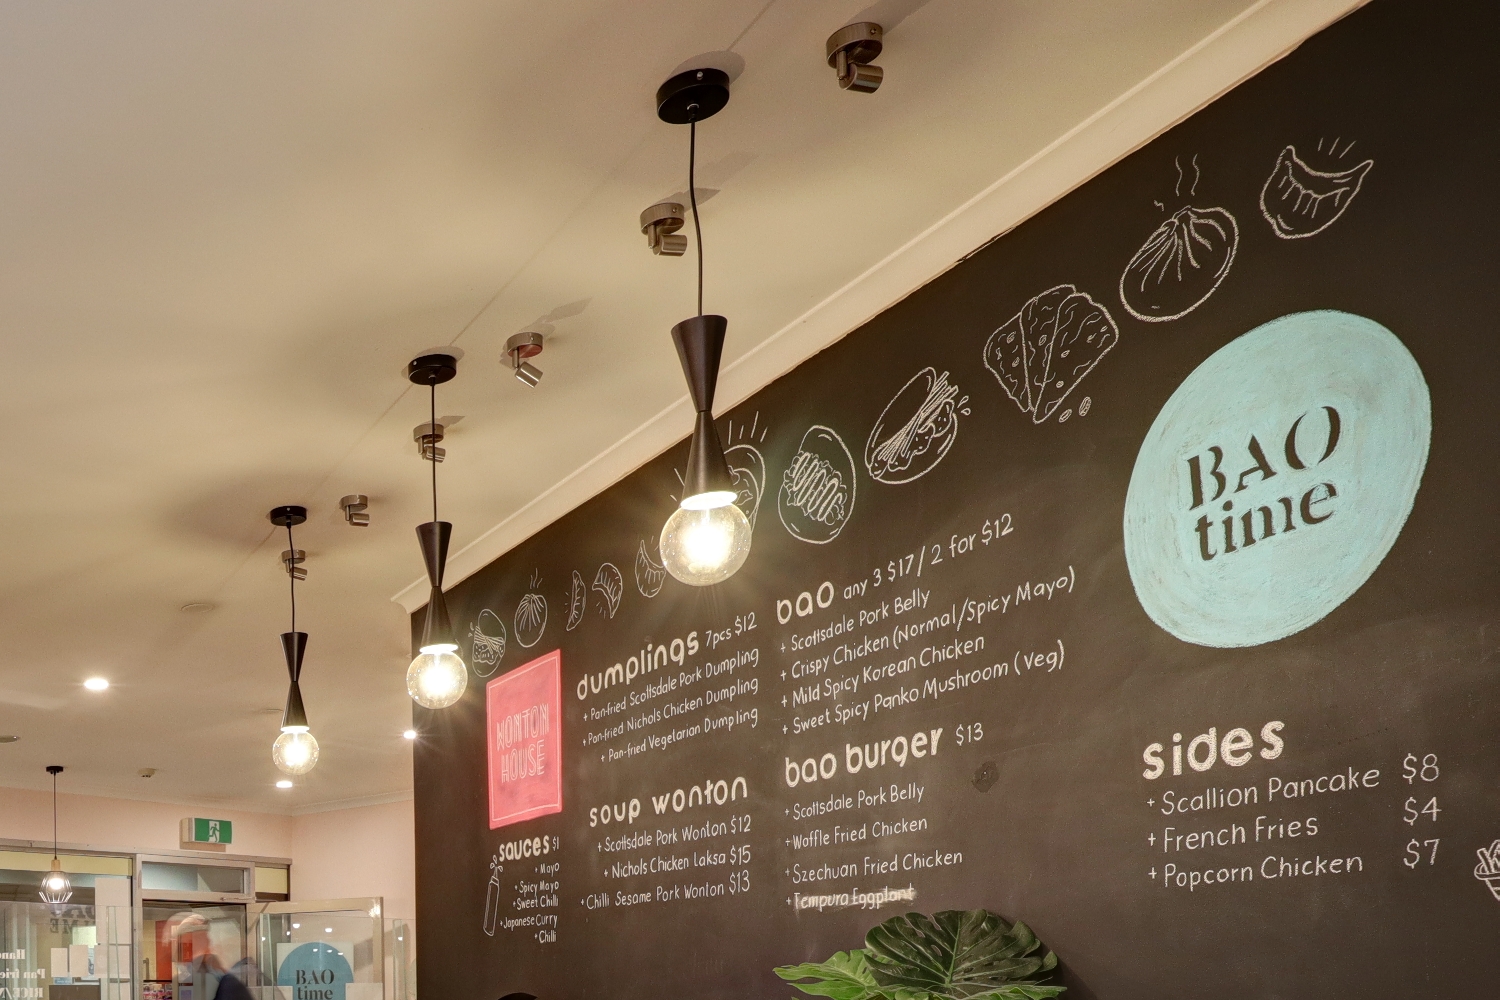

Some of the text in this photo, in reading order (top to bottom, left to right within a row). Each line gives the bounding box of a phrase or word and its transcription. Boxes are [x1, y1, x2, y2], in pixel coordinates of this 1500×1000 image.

[1187, 405, 1341, 511] BAO
[1194, 481, 1339, 562] time
[776, 581, 834, 625] bao
[843, 579, 868, 601] any
[873, 568, 882, 587] 3
[949, 532, 976, 557] for
[981, 513, 1014, 545] $12
[791, 588, 930, 652] Scottsdale Pork Belly
[791, 654, 830, 681] Crispy
[833, 633, 889, 666] Chicken
[1015, 565, 1076, 606] Mayo)
[576, 612, 758, 700] dumplings 7pcs $12
[792, 636, 986, 708] Mild Spicy Korean Chicken
[590, 648, 759, 721] Pan-fried Scottsdale Pork Dumpling
[793, 708, 832, 735] Sweet
[835, 700, 870, 725] Spicy
[874, 686, 920, 713] Panko
[922, 661, 1009, 701] Mushroom
[496, 703, 549, 752] WONTON
[588, 677, 758, 745] Pan-fried Nichols Chicken Dumpling
[609, 708, 758, 761] Pan-fried Vegetarian Dumpling
[501, 739, 545, 784] HOUSE
[785, 722, 984, 788] bao burger $13
[1142, 720, 1285, 780] sides
[590, 776, 748, 827] soup wonton
[793, 782, 925, 821] Scottsdale Pork Belly
[1161, 752, 1440, 815] Scallion Pancake $8
[499, 835, 560, 862] sauces $1
[604, 814, 751, 852] Scottsdale Pork Wonton $12
[792, 818, 928, 850] Waffle Fried Chicken
[1163, 796, 1442, 853] French Fries $4
[540, 862, 560, 877] Mayo
[612, 845, 751, 878] Nichols Chicken Laksa $15
[792, 849, 963, 884] Szechuan Fried Chicken
[1164, 838, 1440, 892] Popcorn Chicken $7
[517, 894, 558, 910] Sweet Chilli
[519, 880, 559, 897] Spicy Mayo
[586, 869, 750, 910] Chilli Sesame Pork Wonton $13
[503, 914, 557, 931] Japanese Curry
[539, 930, 556, 943] Chilli
[295, 969, 334, 985] BAO
[297, 986, 333, 1000] time
